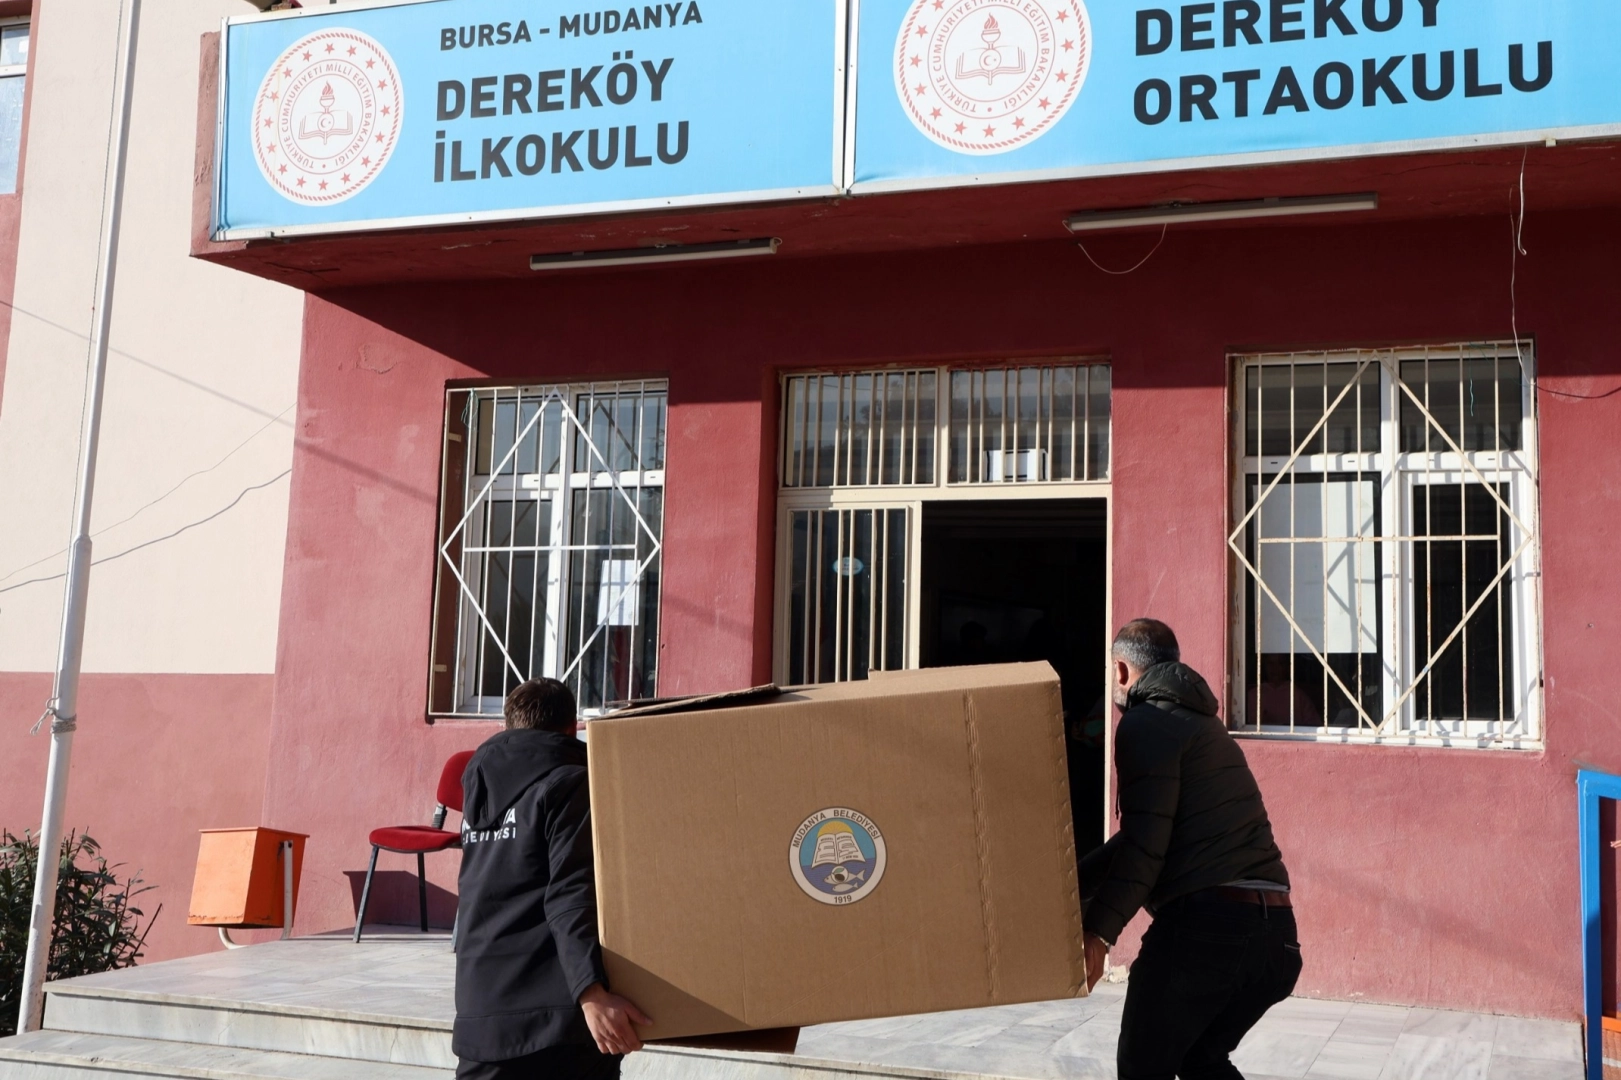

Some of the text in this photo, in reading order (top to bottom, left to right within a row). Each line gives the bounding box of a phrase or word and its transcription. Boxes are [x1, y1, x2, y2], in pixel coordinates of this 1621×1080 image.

[440, 20, 532, 51] BURSA
[559, 0, 703, 39] MUDANYA
[1023, 2, 1050, 43] EĞİTİM
[436, 50, 674, 121] DEREKÖY
[936, 76, 977, 113] TÜRKİYE
[1003, 48, 1051, 110] BAKANLIĞI
[1133, 40, 1553, 126] ORTAOKULU
[282, 62, 372, 169] TÜRKİYE CUMHURİYETİ MİLLİ EĞİTİM BAKANLIĞI
[434, 120, 689, 183] İLKOKULU
[792, 809, 881, 848] MUDANYA BELEDİYESİ
[834, 895, 852, 904] 1919
